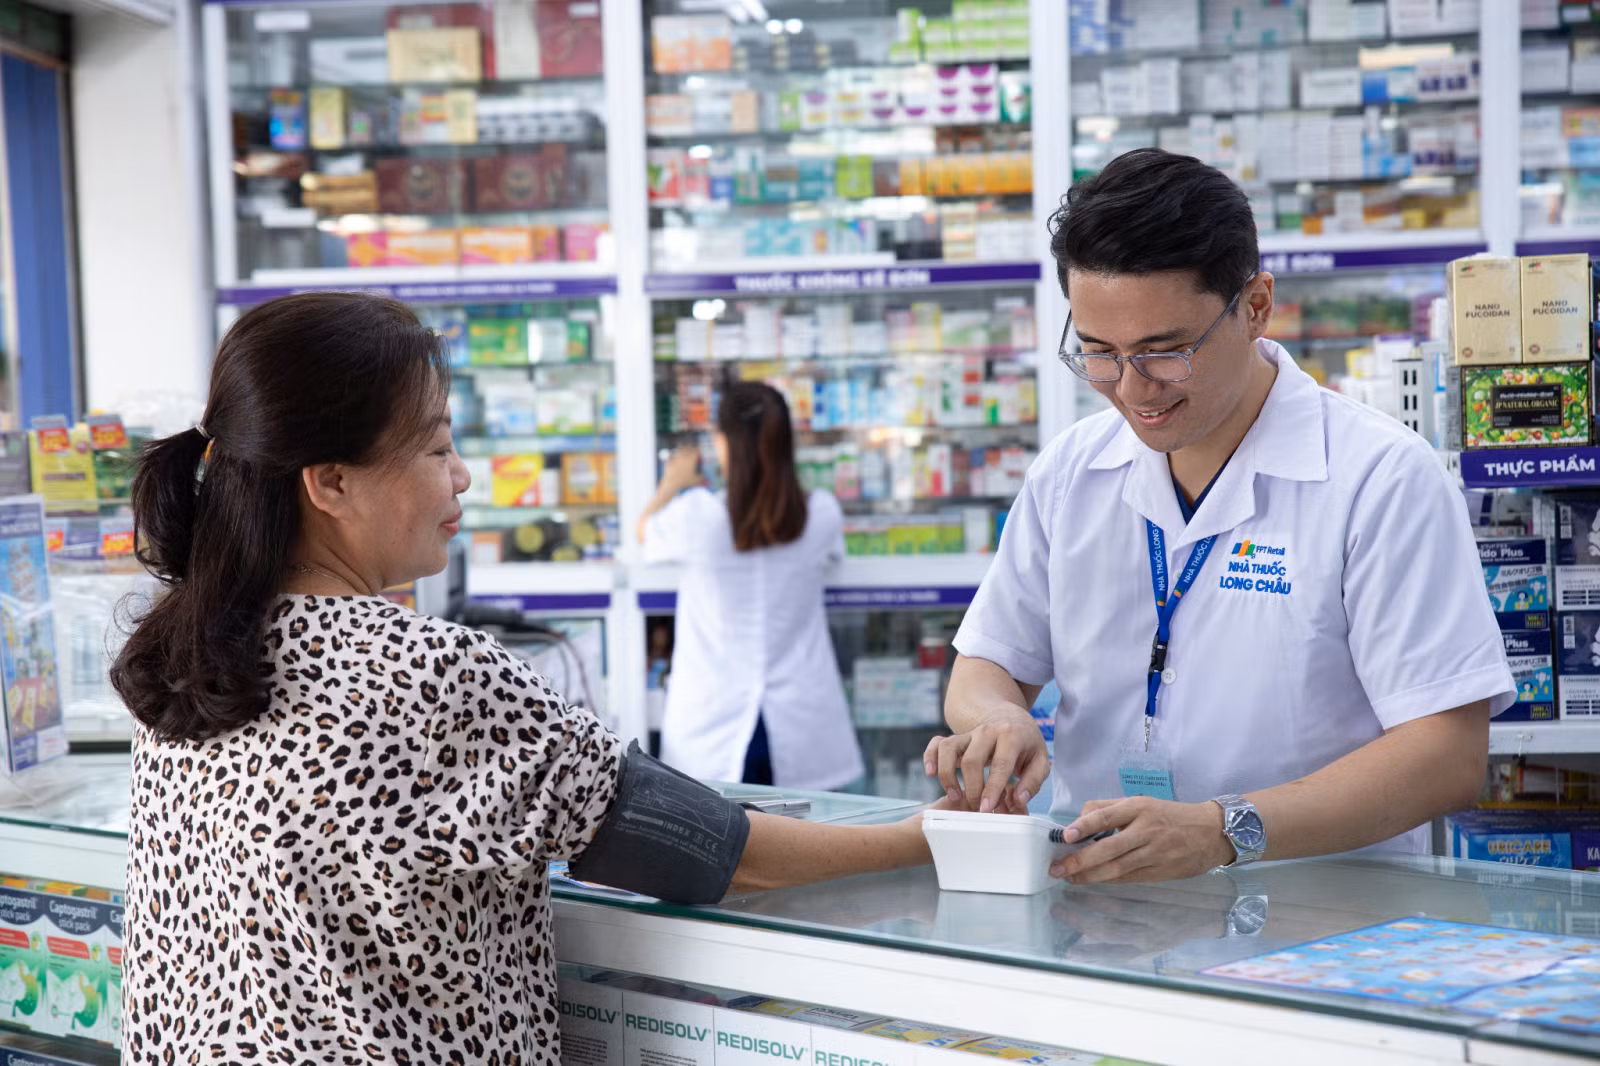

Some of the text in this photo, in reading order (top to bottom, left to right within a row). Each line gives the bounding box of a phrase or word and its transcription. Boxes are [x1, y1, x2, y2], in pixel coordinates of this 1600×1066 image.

[1475, 303, 1500, 311] NANO
[1532, 306, 1578, 315] FUCOIDAN
[1542, 300, 1568, 308] NANO
[1465, 310, 1510, 319] FUCOIDAN
[1484, 454, 1595, 478] THỰC PHẨM
[1152, 528, 1161, 549] LONG
[1256, 545, 1285, 556] FPT Retail
[1480, 548, 1524, 558] ido Plus
[1228, 559, 1286, 576] NHÀ THUỐC
[1219, 576, 1291, 595] LONG CHÂU
[1505, 639, 1528, 649] Plus
[663, 820, 691, 837] INDEX
[0, 894, 37, 910] ptogastril
[49, 900, 97, 919] Captogastril
[74, 922, 90, 932] pack
[560, 1000, 617, 1024] DISOLV
[625, 1013, 708, 1042] REDISOLV
[717, 1031, 804, 1061] REDISOLV
